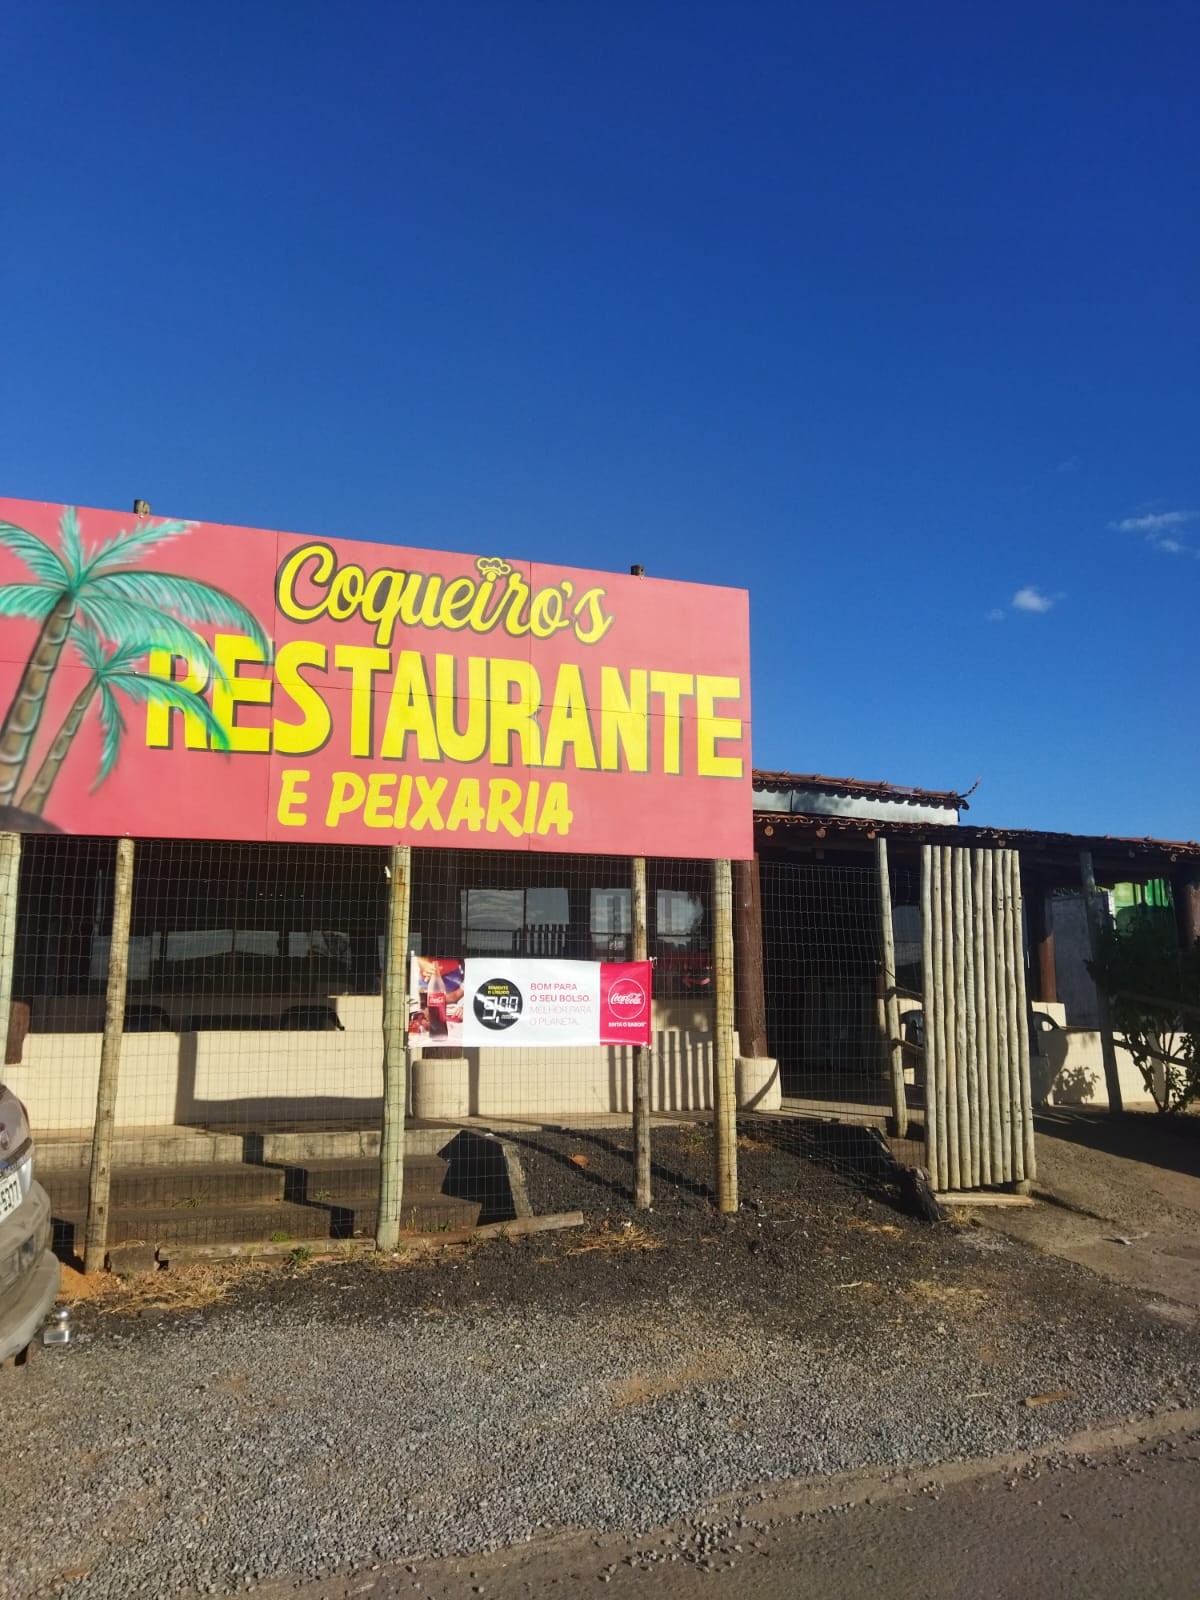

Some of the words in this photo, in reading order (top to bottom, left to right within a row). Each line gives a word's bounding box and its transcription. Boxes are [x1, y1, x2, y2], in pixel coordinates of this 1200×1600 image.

[277, 542, 612, 647] Coqueiro's
[145, 630, 744, 778] RESTAURANTE
[277, 770, 310, 826] E
[325, 772, 574, 837] PEIXARIA
[530, 983, 551, 991] BOM
[554, 983, 577, 991] PARA
[530, 994, 538, 1002] O
[540, 994, 557, 1002] SEU
[611, 992, 642, 1005] Coca-Cola
